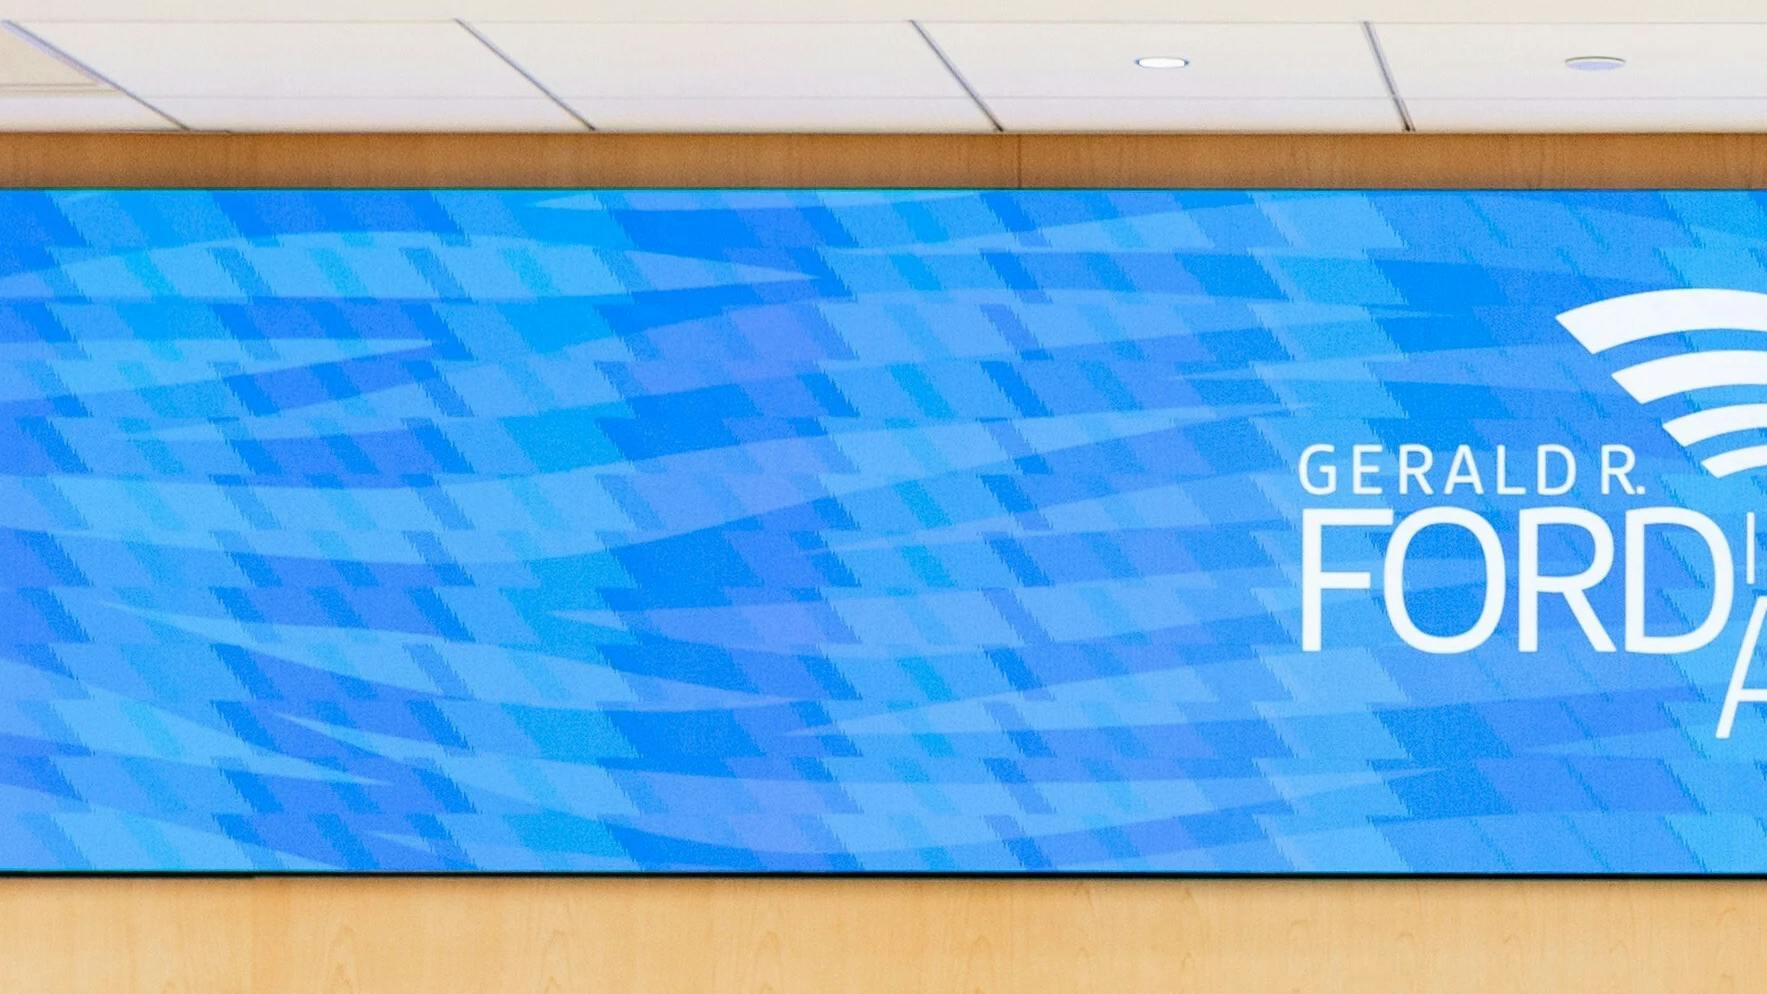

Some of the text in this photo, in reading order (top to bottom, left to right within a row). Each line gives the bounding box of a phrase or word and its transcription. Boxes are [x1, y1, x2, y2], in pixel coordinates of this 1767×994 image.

[1299, 444, 1645, 495] GERALD R.
[1302, 507, 1733, 654] FORD
